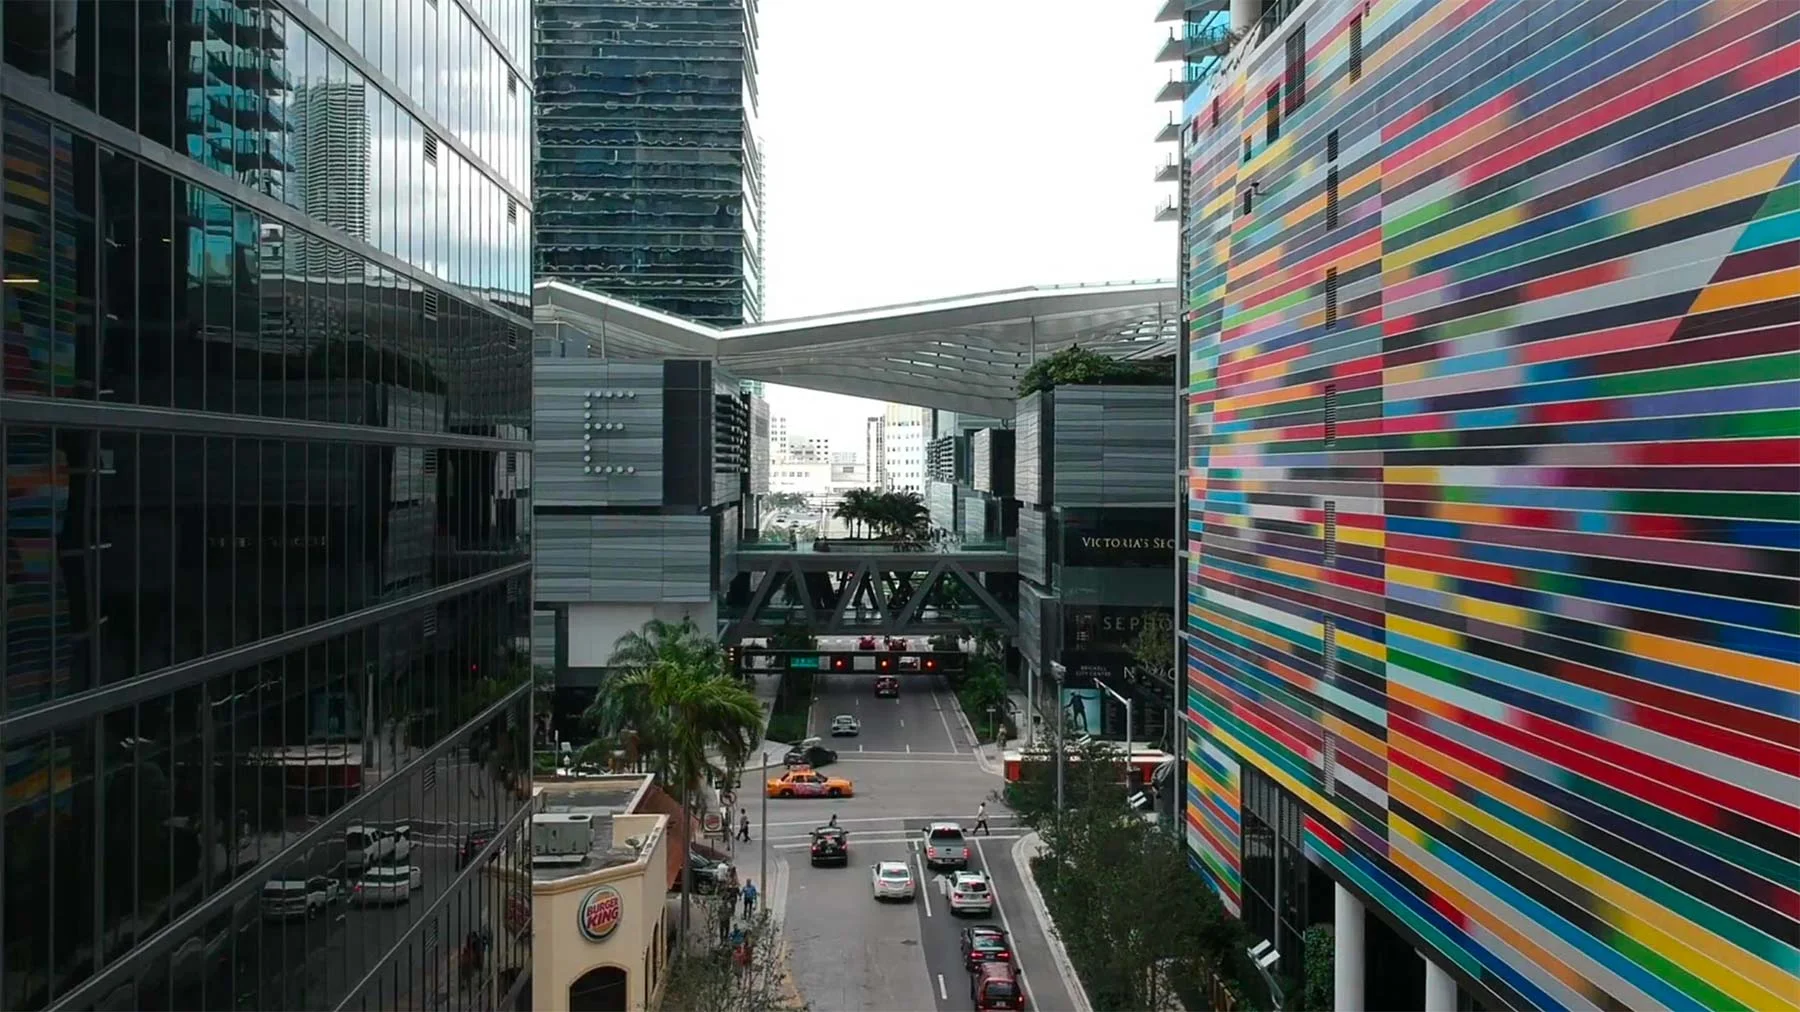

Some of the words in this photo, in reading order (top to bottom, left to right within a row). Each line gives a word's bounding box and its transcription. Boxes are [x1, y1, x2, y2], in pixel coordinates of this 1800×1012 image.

[1082, 536, 1150, 548] VICTORIA'S
[586, 897, 619, 916] BURGER
[587, 906, 619, 928] KING
